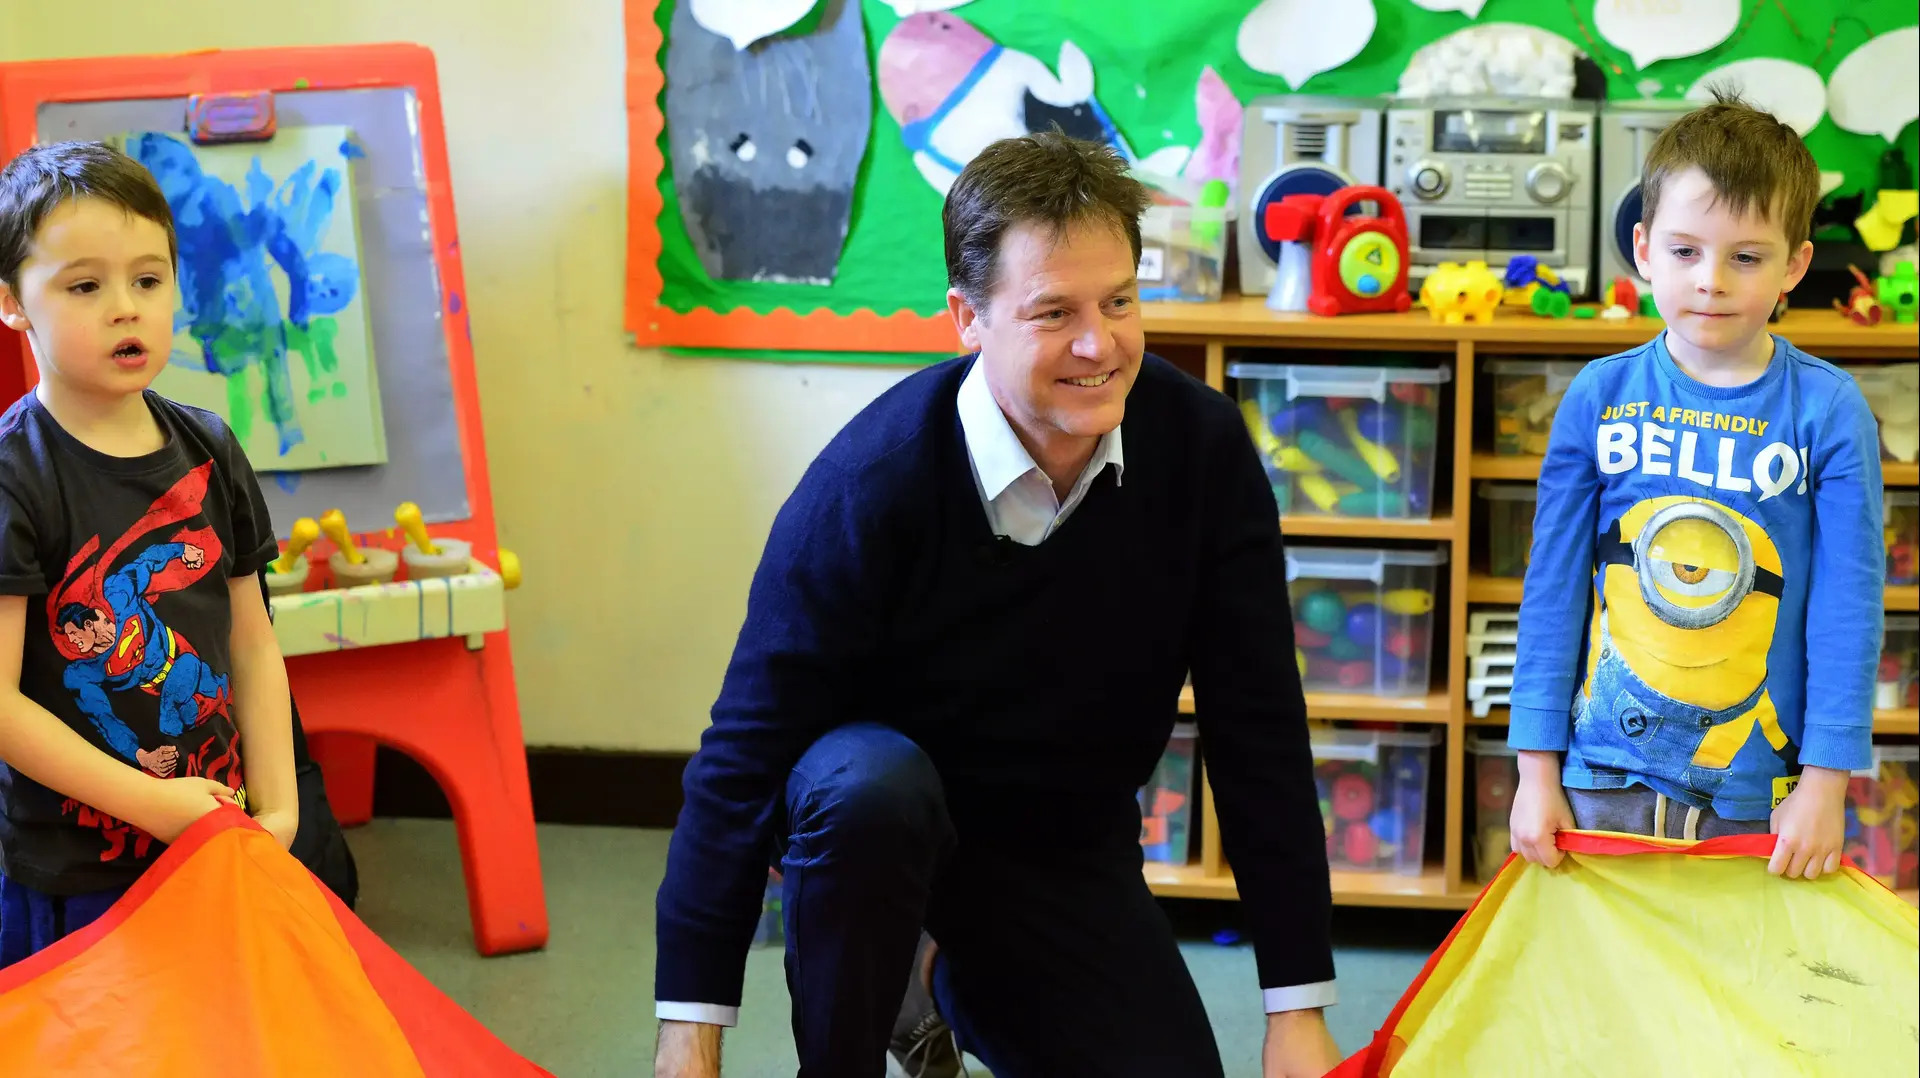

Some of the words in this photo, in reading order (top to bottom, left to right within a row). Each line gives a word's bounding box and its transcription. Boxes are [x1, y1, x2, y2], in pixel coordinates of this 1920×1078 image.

[1601, 401, 1650, 420] JUST
[1651, 406, 1666, 422] A
[1669, 406, 1769, 437] FRIENDLY
[1597, 422, 1809, 503] BELLO!
